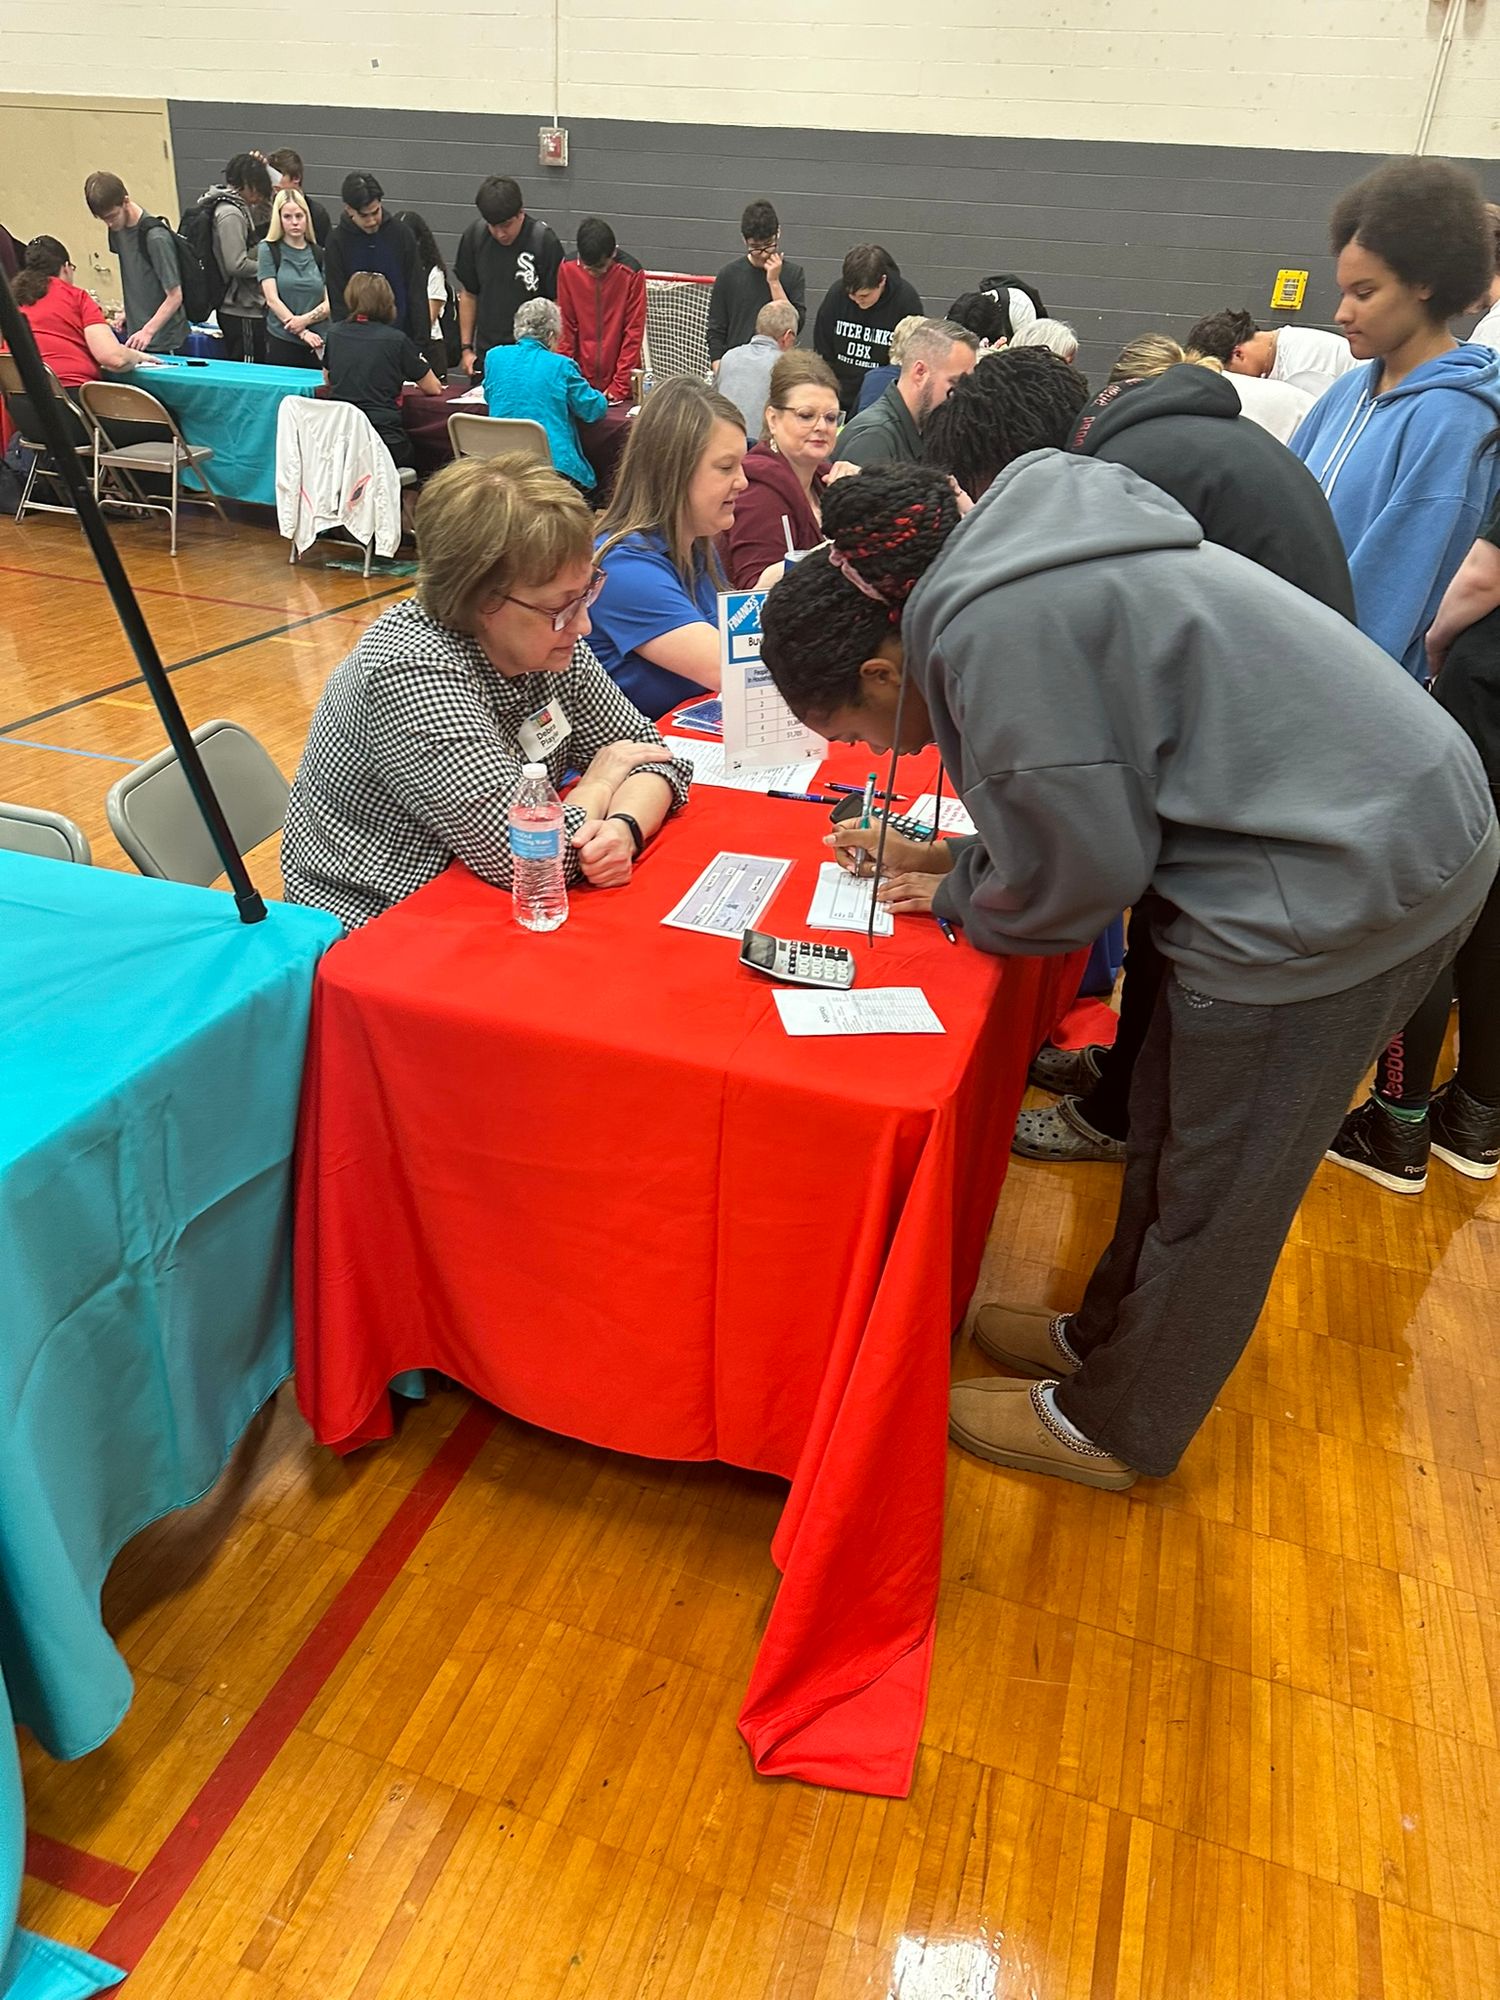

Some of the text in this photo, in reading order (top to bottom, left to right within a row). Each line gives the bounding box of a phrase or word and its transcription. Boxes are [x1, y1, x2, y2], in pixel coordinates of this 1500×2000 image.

[836, 320, 863, 339] UTER
[847, 341, 871, 359] OBX
[728, 595, 759, 631] FINANCES
